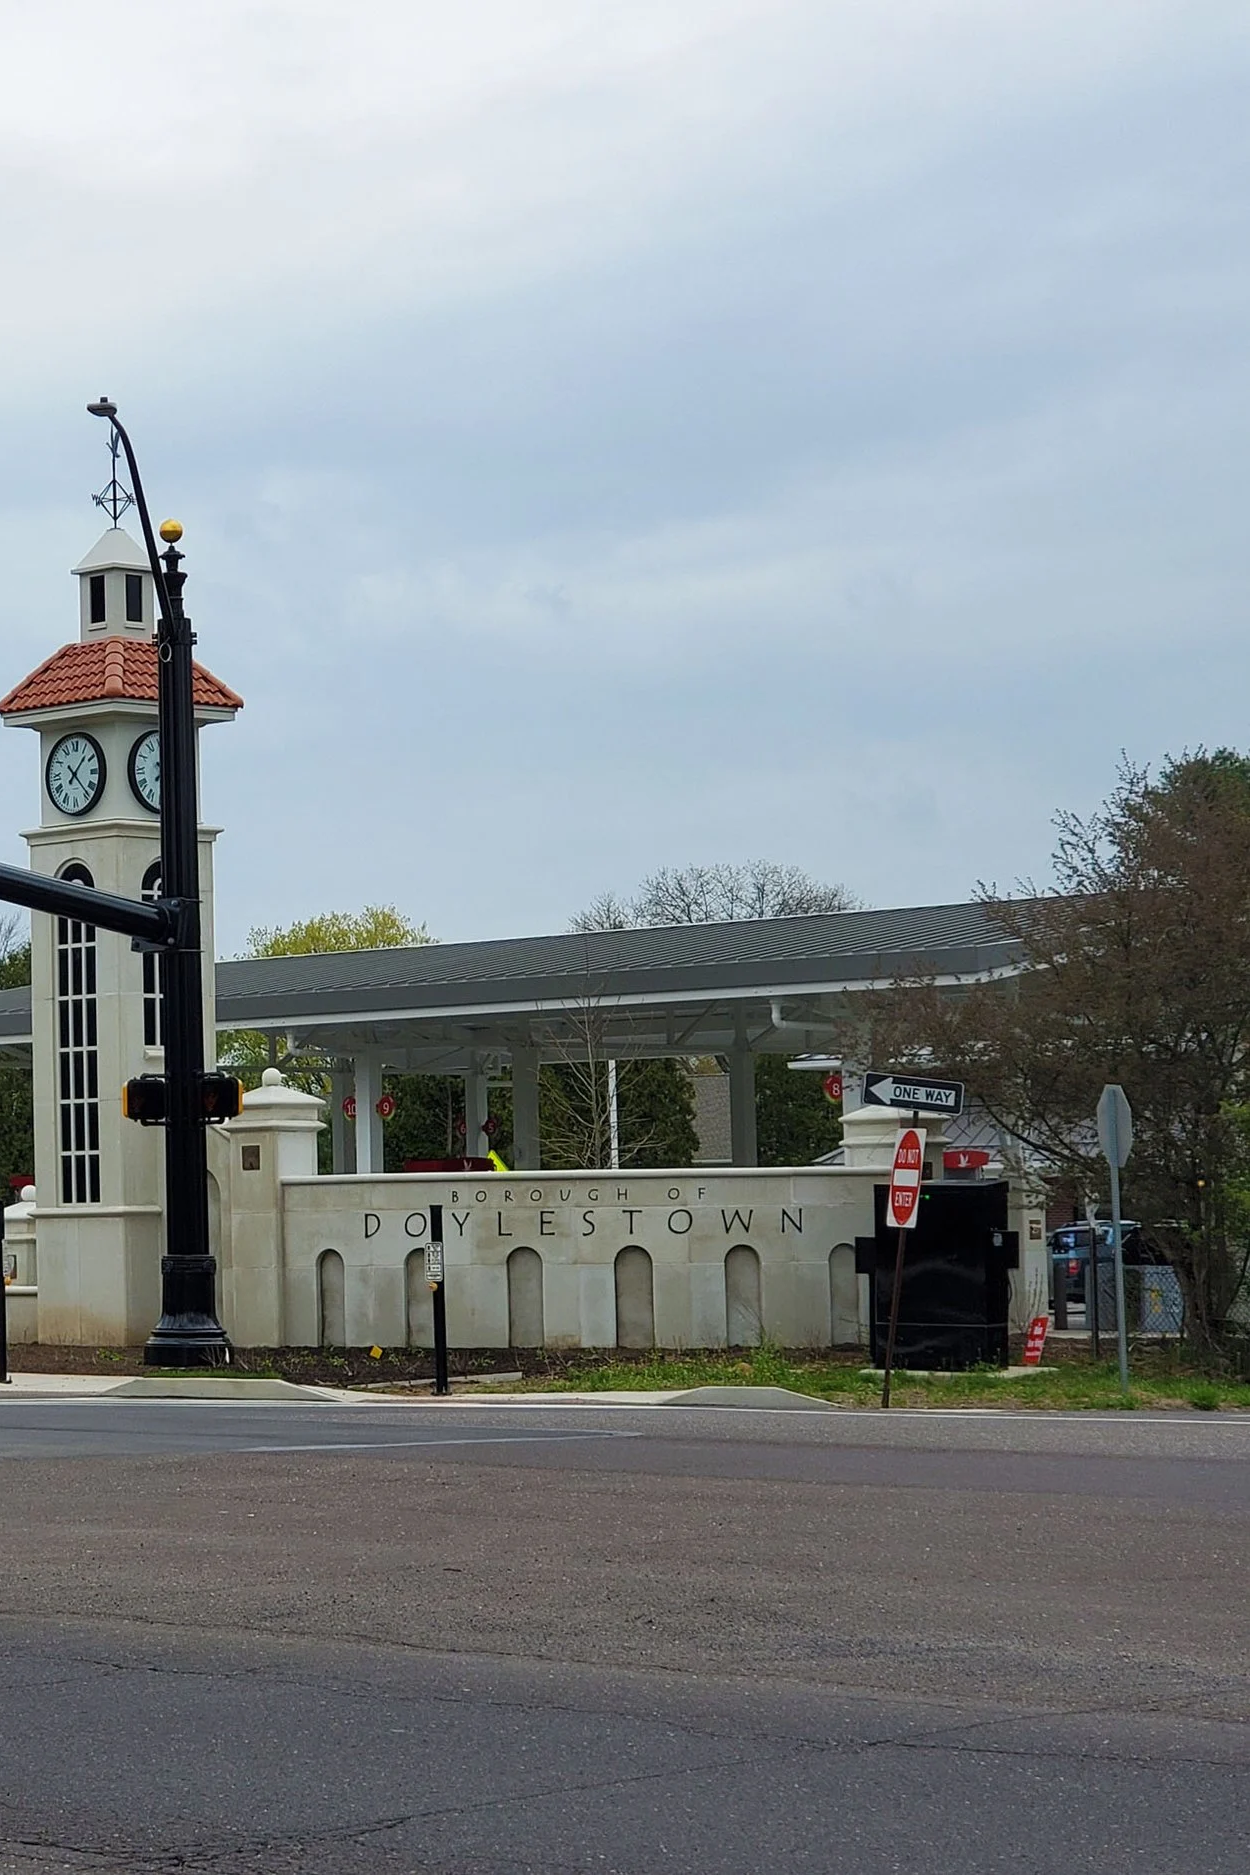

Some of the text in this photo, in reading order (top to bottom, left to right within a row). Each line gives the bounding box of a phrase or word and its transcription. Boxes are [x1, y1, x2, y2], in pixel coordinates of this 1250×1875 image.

[832, 1082, 840, 1096] 8
[893, 1085, 953, 1104] ONE WAY
[383, 1102, 390, 1114] 9
[897, 1148, 920, 1165] DO NOT
[451, 1187, 706, 1203] BOROUGH OF
[364, 1207, 803, 1239] DOYLESTOWN
